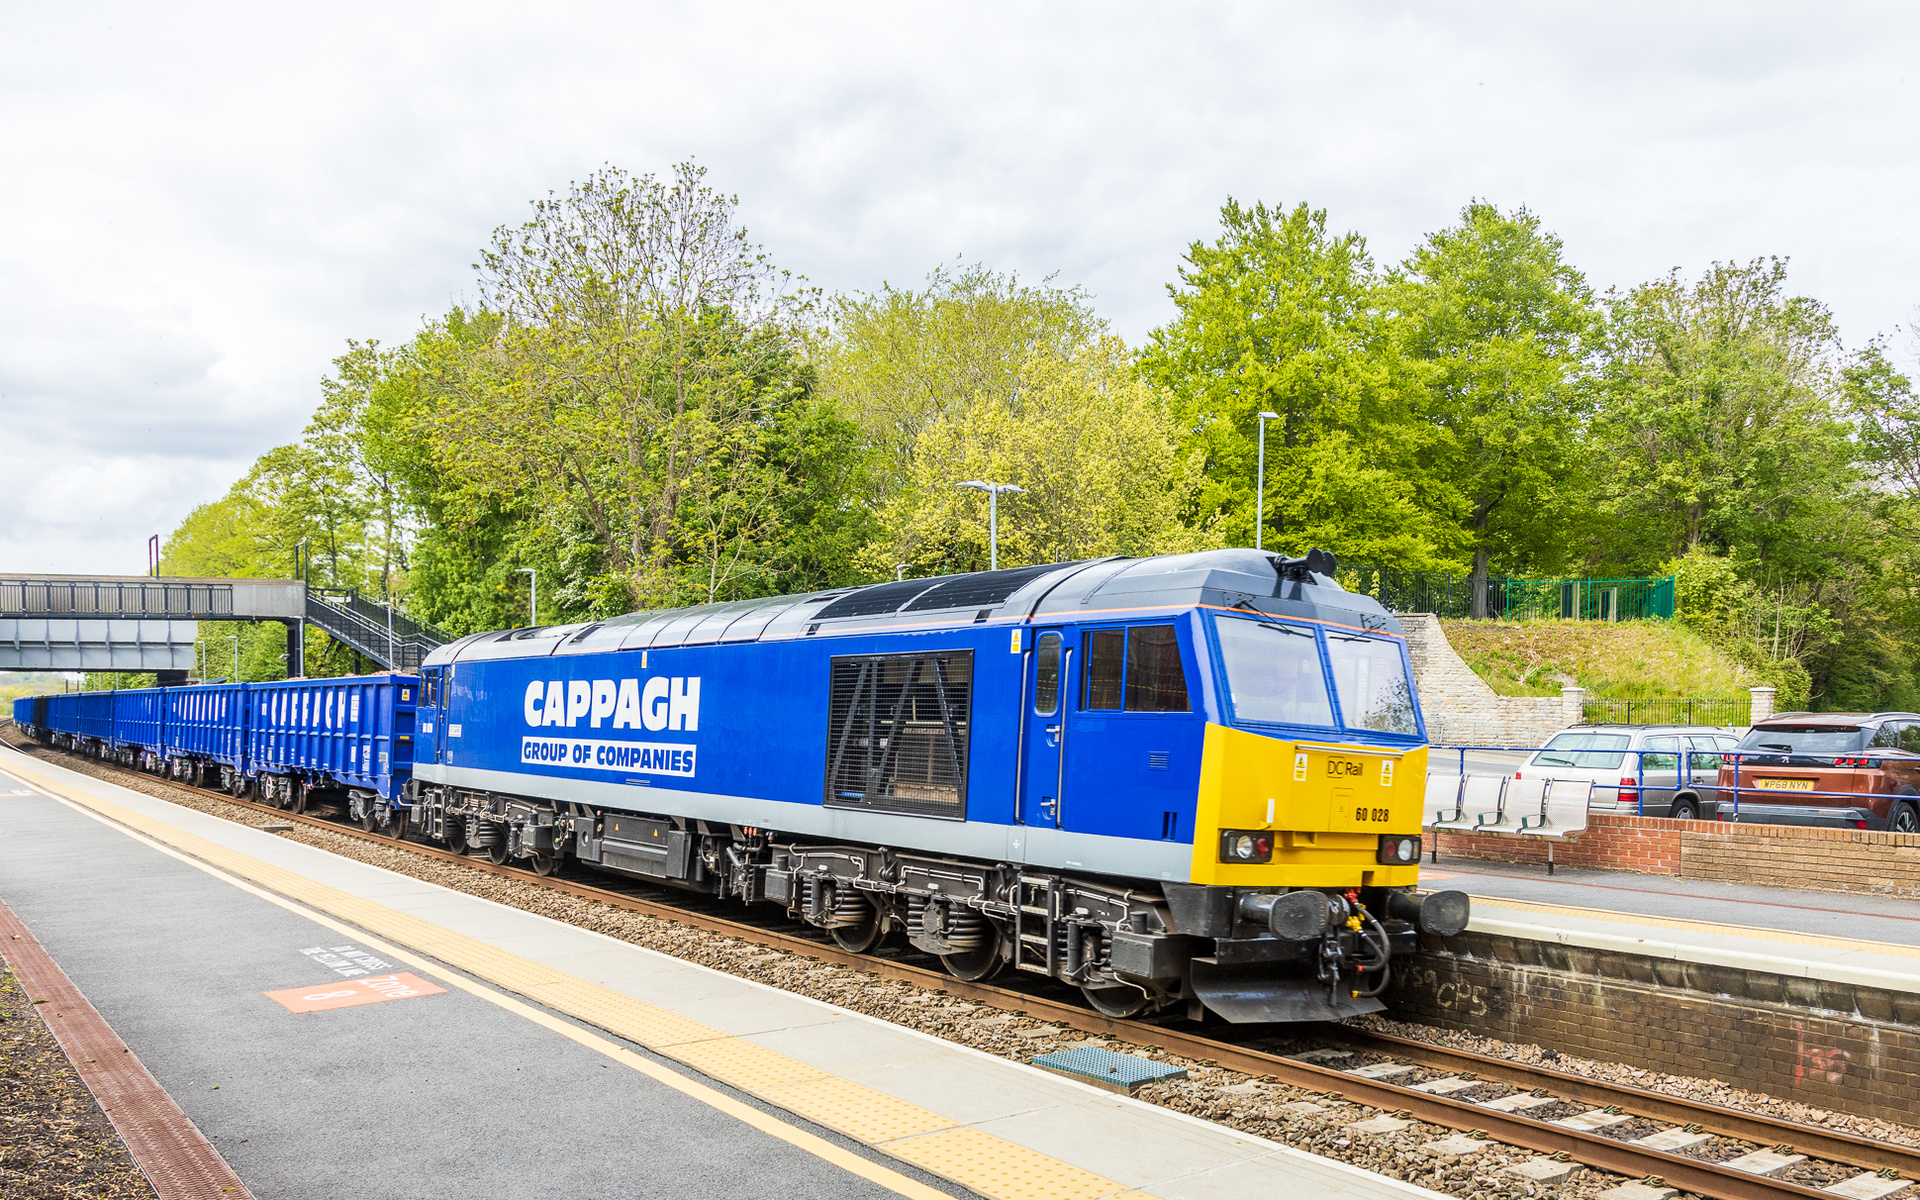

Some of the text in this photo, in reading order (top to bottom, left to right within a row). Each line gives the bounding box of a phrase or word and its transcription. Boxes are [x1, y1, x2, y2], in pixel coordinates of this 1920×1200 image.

[524, 676, 701, 732] CAPPAGH
[523, 741, 694, 773] GROUP OF COMPANIES
[1763, 780, 1809, 790] WP68 NYN
[1355, 807, 1390, 822] 60 028
[302, 990, 357, 1001] 8
[357, 975, 419, 998] Zone
